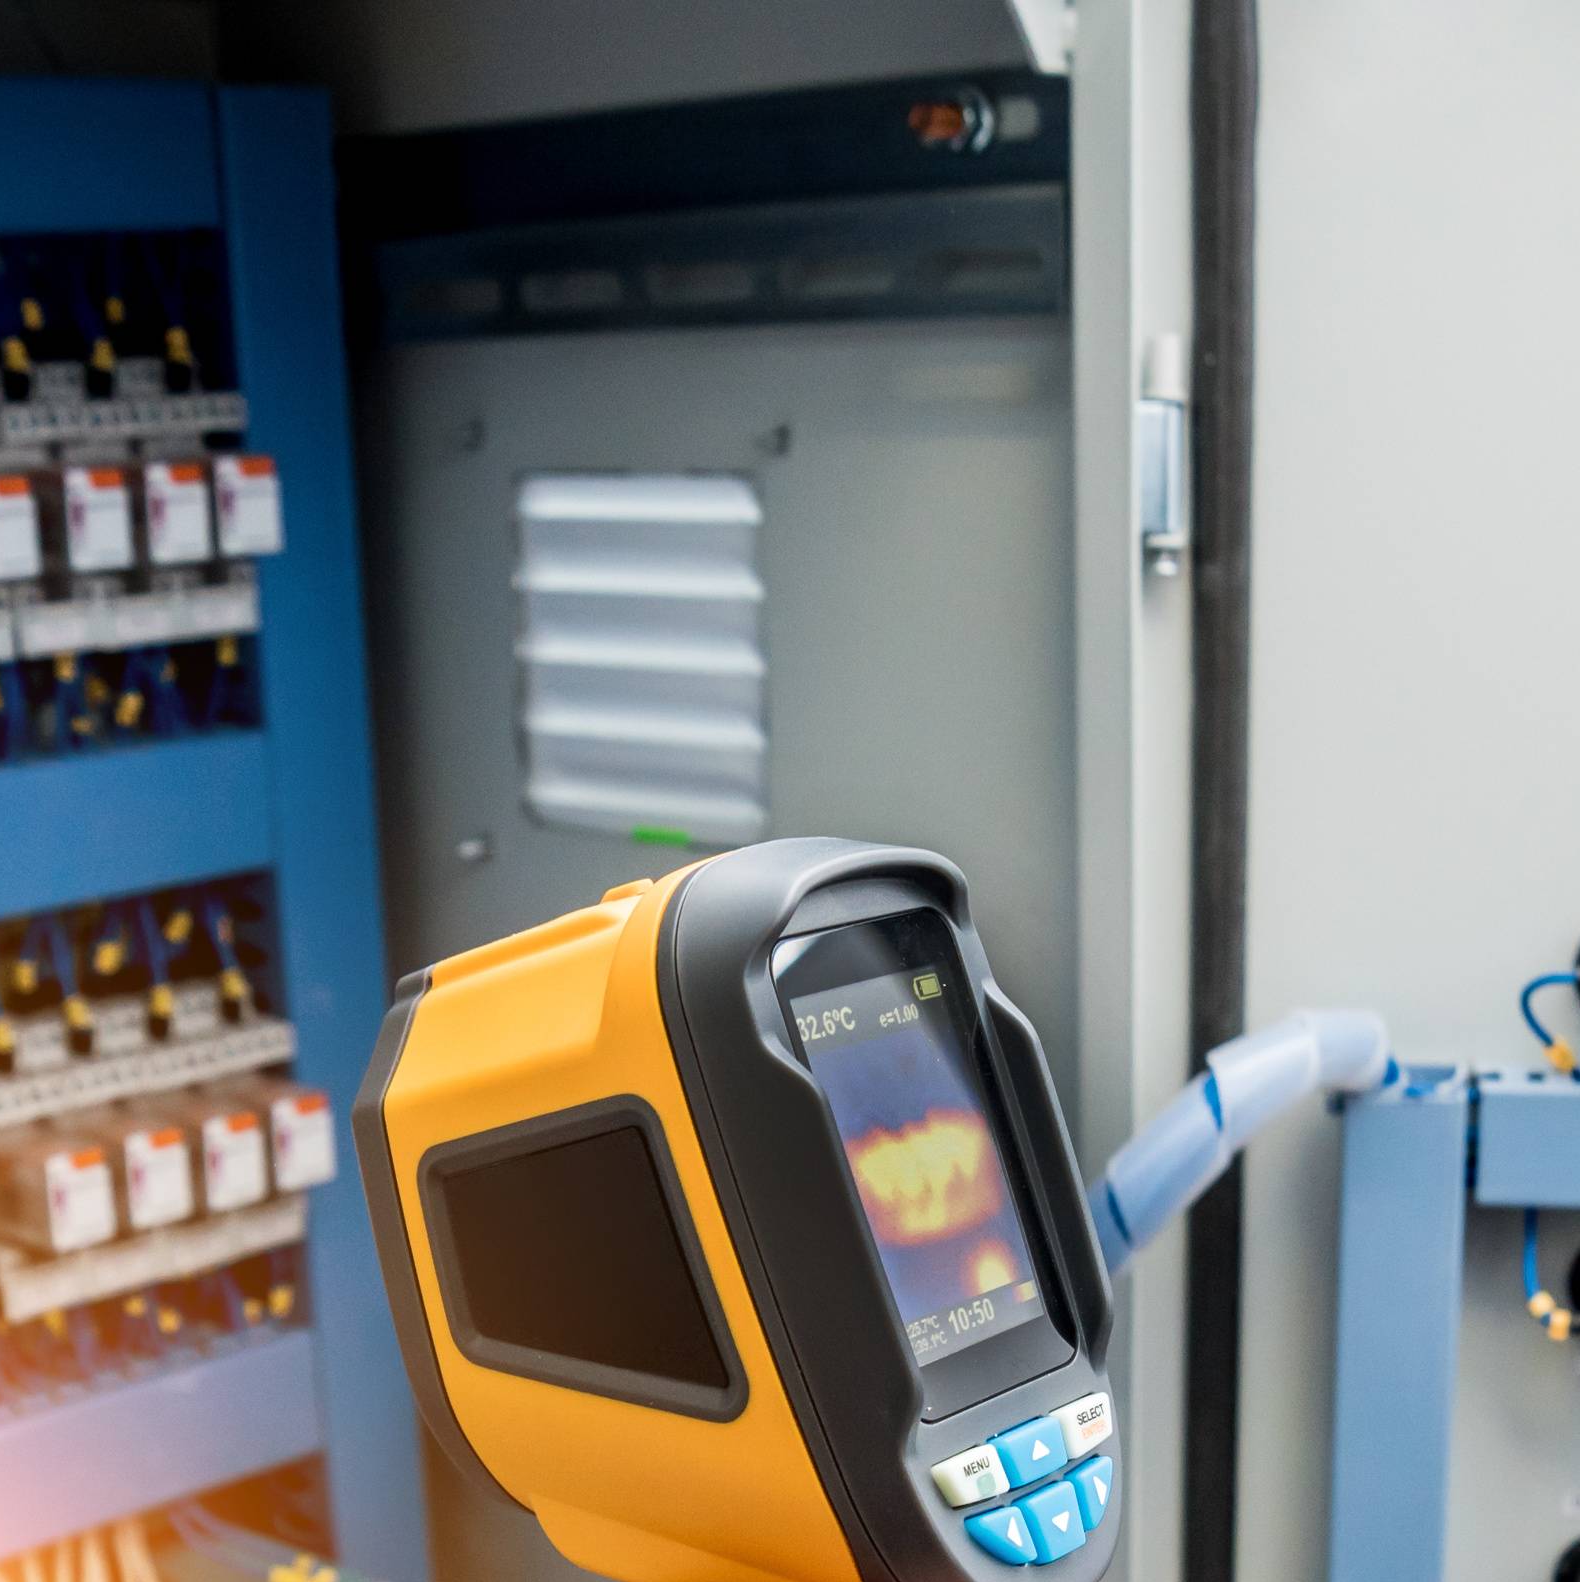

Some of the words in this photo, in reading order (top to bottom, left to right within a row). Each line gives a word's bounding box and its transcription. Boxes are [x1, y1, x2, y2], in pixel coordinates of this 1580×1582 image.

[879, 1003, 919, 1028] e=1.00
[948, 1298, 995, 1335] 10:50
[1076, 1403, 1105, 1426] SELECT
[963, 1456, 991, 1478] MENU
